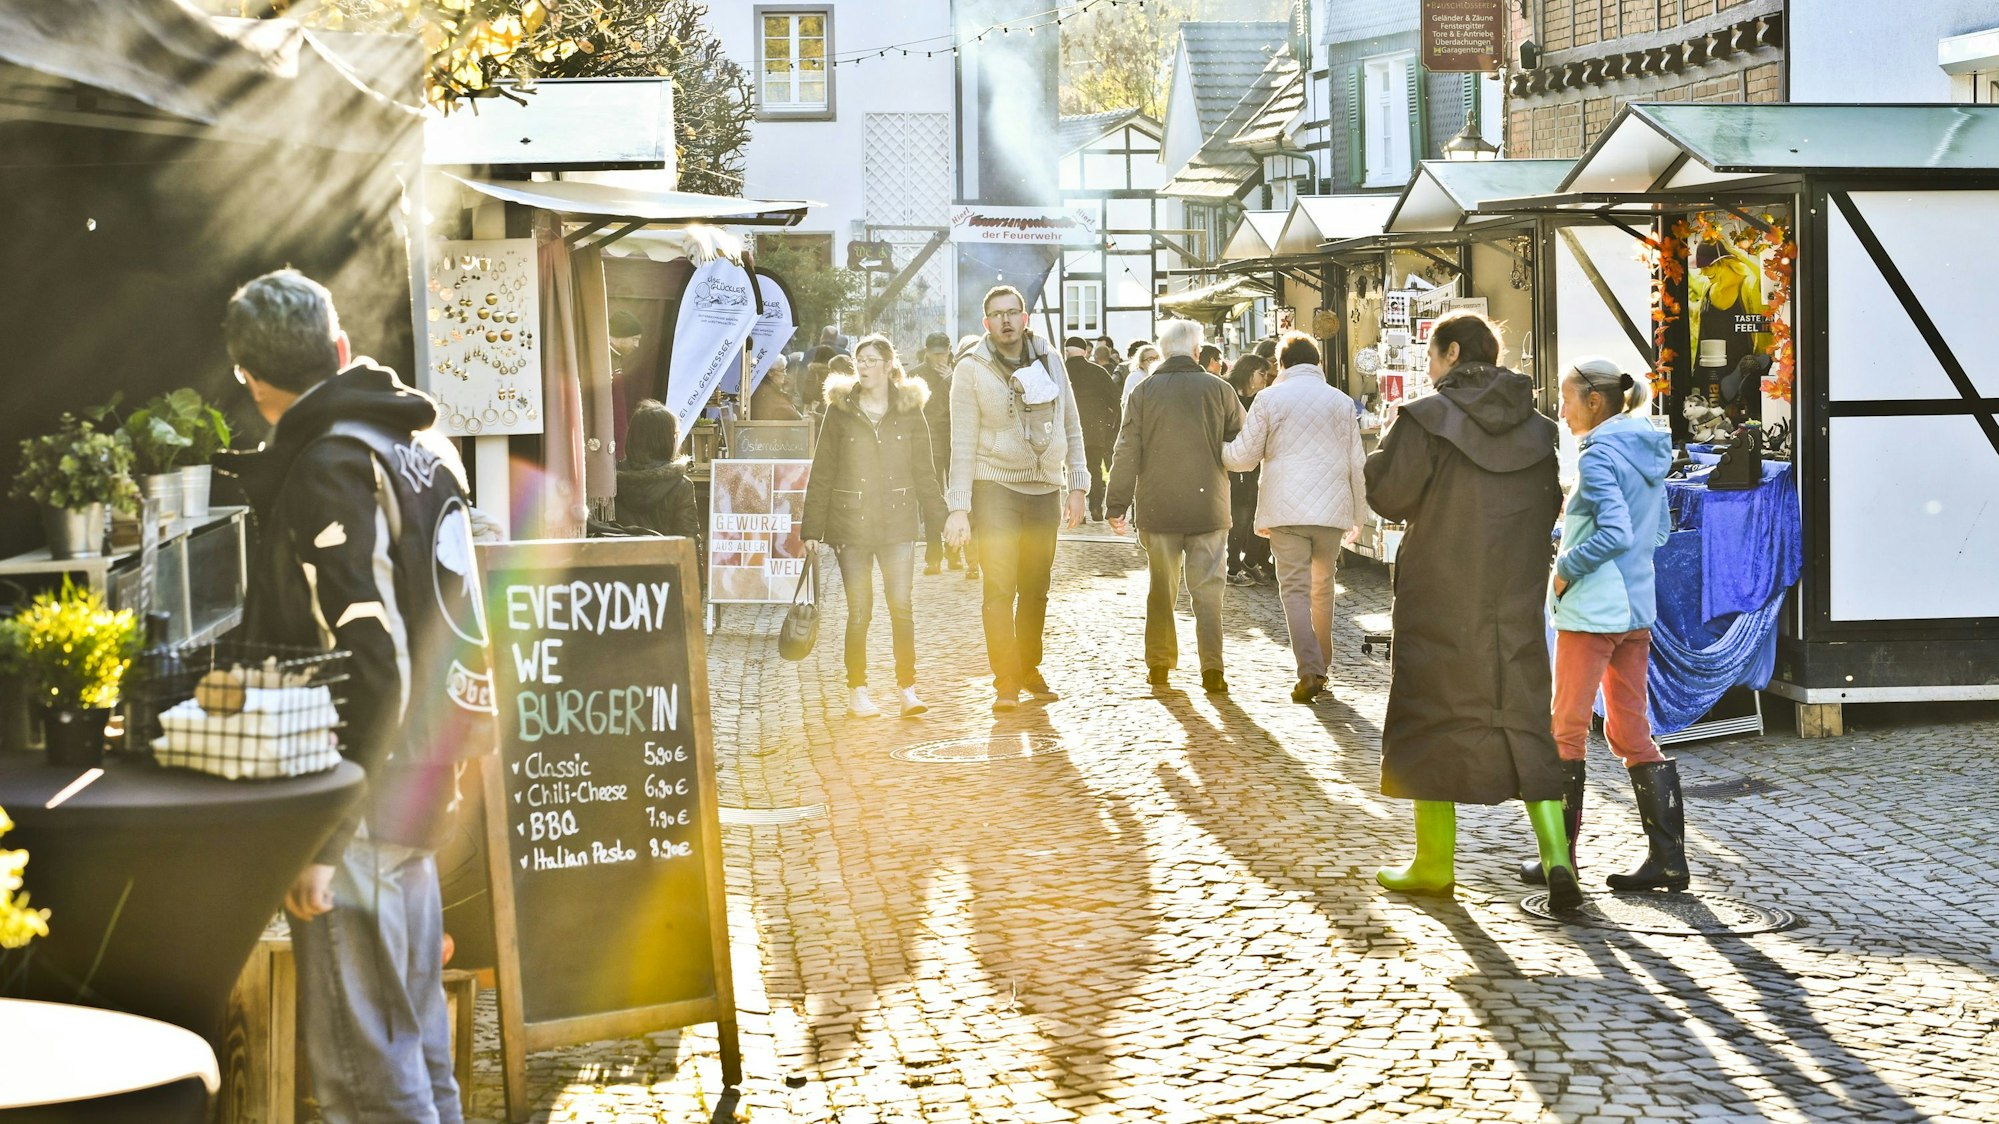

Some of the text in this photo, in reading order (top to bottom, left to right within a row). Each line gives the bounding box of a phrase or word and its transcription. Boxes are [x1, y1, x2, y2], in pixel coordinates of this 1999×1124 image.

[1432, 30, 1494, 38] Tore & E-Antriebe
[1440, 22, 1485, 31] Fenstergitter
[1435, 38, 1491, 47] Überdachungen
[1441, 46, 1486, 54] Garagentore
[951, 206, 970, 225] Hier!
[981, 230, 1063, 241] der Feuerwehr
[1734, 314, 1761, 323] TASTE
[1734, 323, 1759, 333] FEEL
[699, 339, 733, 389] GENIESSER
[715, 541, 766, 552] AUS ALLER
[506, 580, 670, 635] EVERYDAY
[511, 638, 563, 684] WE
[524, 751, 592, 780] Classic
[527, 780, 628, 808] Chili-Cheese
[529, 809, 580, 842] BBQ
[533, 845, 589, 872] Italian
[591, 838, 637, 865] Pesto
